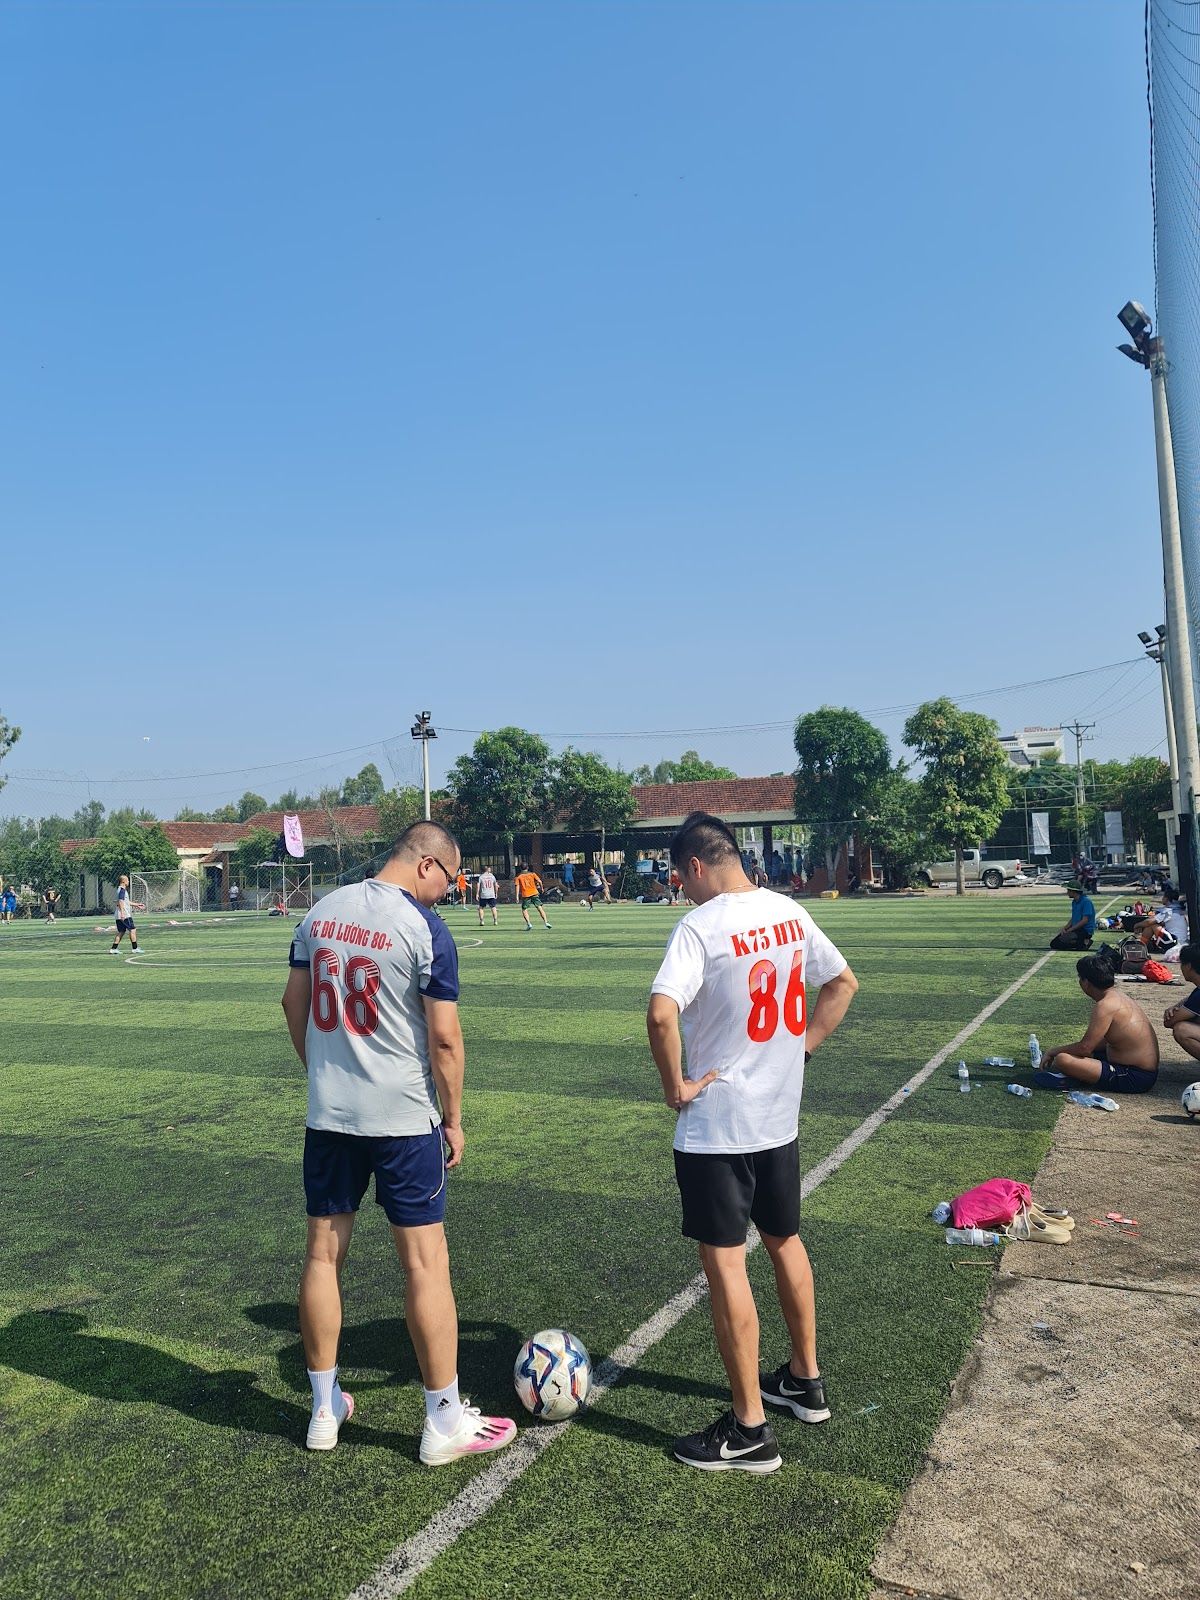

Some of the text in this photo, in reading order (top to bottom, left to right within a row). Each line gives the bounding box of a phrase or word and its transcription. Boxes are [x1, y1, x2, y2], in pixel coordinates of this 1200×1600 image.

[309, 920, 321, 938] FC
[370, 931, 393, 951] 80+
[730, 926, 770, 957] K75
[312, 947, 381, 1037] 68
[747, 950, 806, 1042] 86
